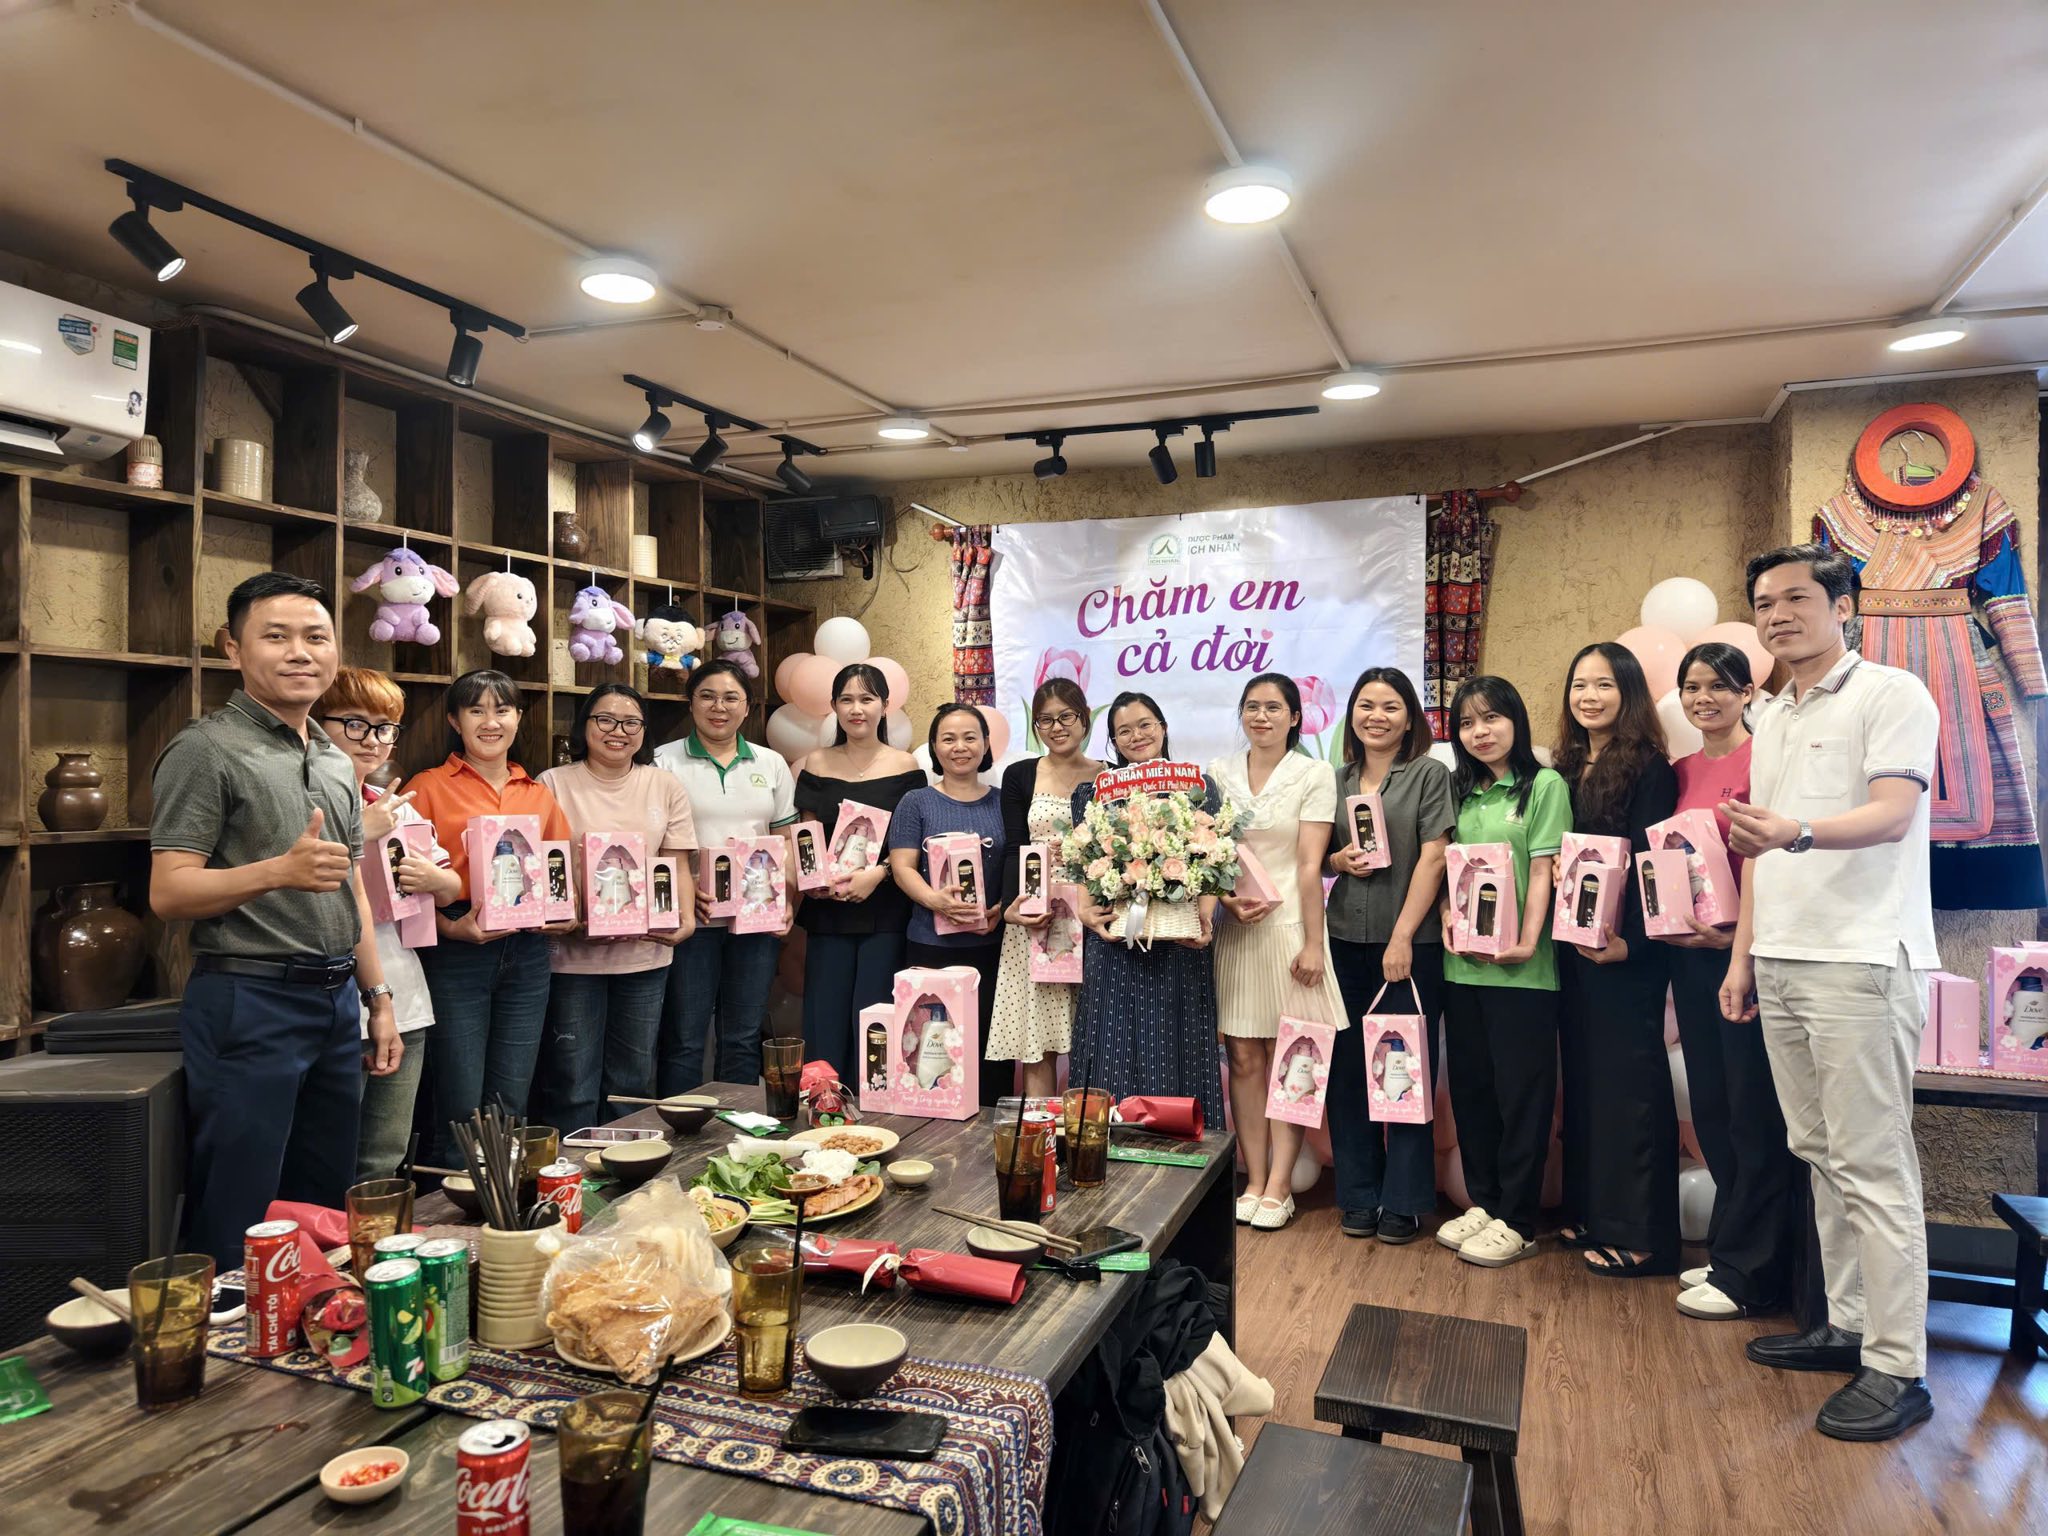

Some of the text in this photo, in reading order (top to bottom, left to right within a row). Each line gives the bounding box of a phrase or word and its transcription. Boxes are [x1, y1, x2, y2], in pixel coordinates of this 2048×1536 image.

[1077, 575, 1305, 638] Chăm em
[1117, 625, 1274, 677] cả đời
[1174, 766, 1197, 778] NAM
[1721, 787, 1734, 798] H
[2023, 1004, 2044, 1014] Dove
[926, 1038, 945, 1049] Dove
[266, 1293, 279, 1312] TÔI
[265, 1311, 279, 1334] CHẾ
